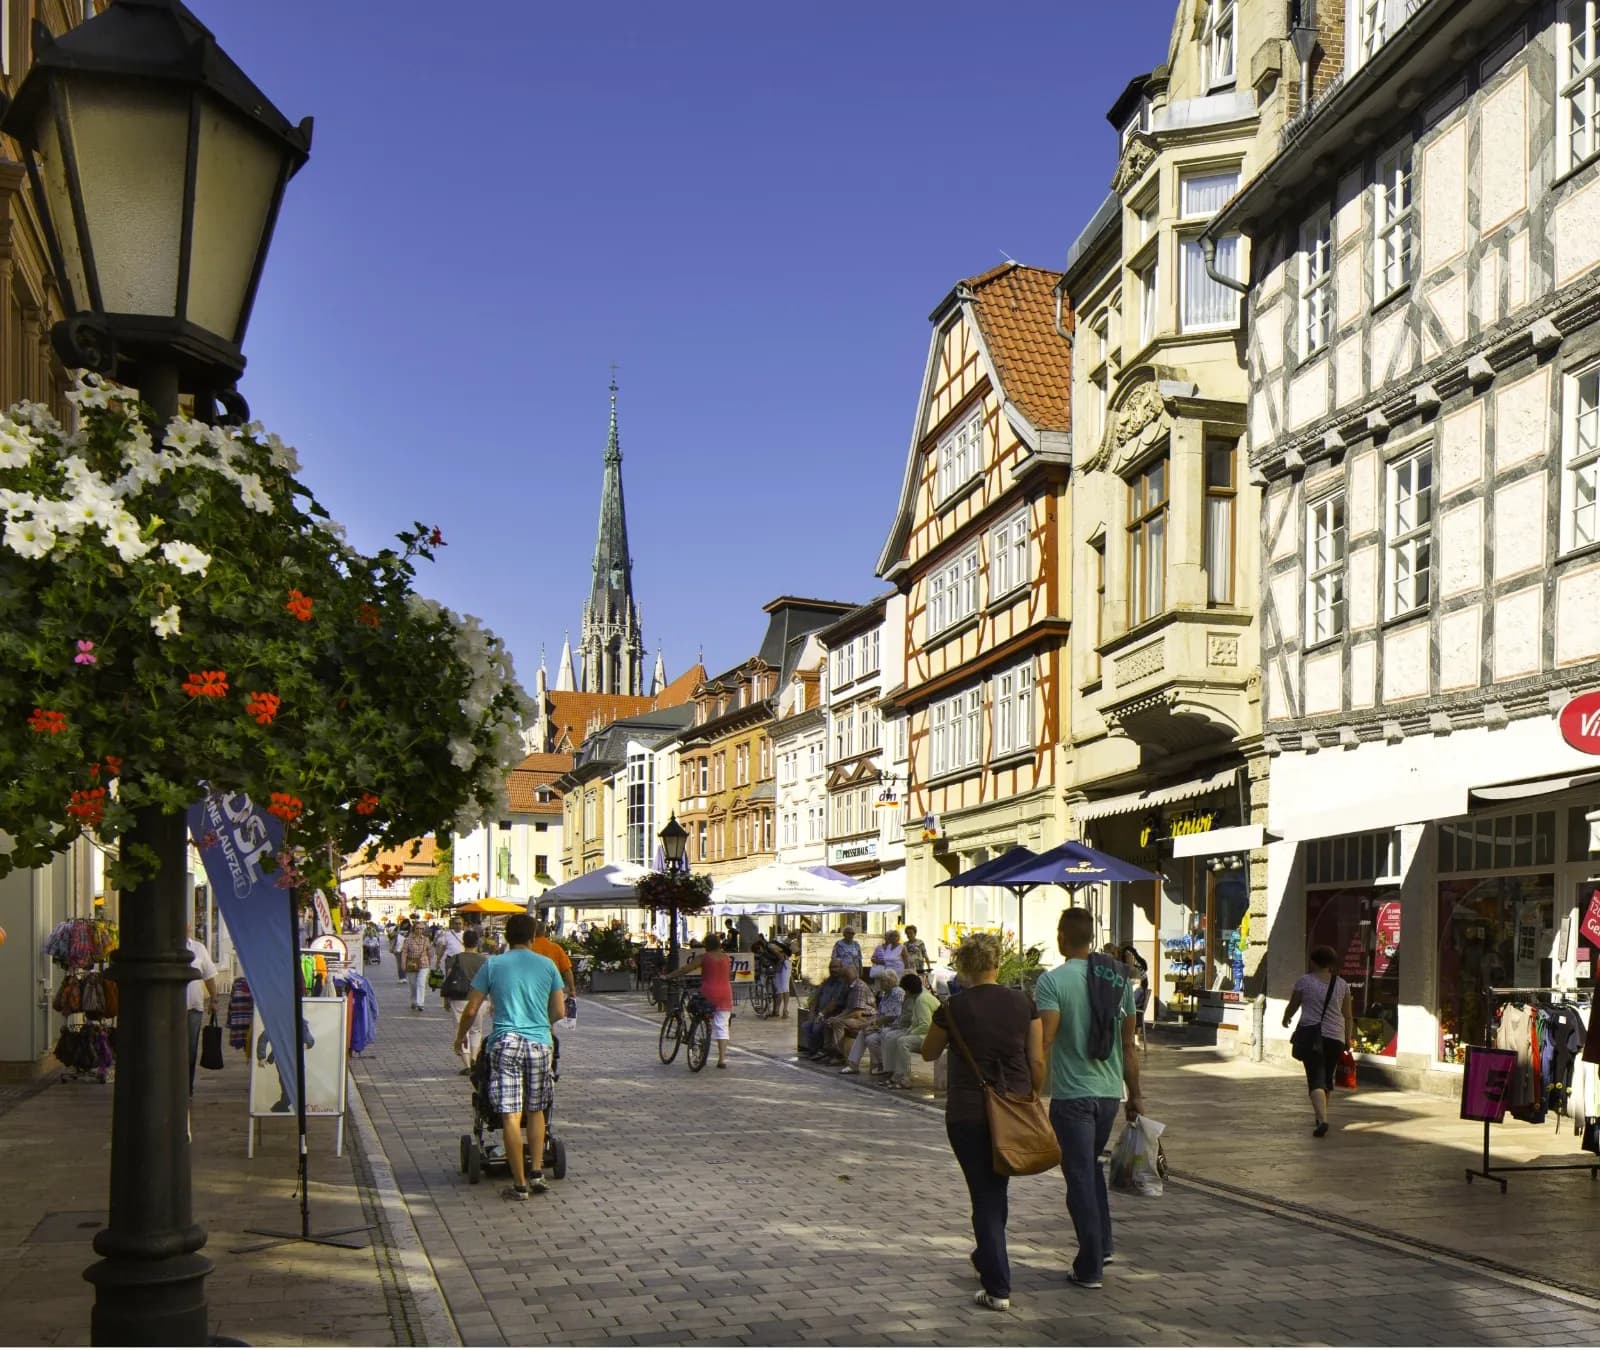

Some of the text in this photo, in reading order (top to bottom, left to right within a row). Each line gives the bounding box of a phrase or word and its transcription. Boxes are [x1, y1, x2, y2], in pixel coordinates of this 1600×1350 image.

[1581, 708, 1600, 737] Vi
[878, 790, 898, 802] dm
[222, 790, 273, 884] DSL
